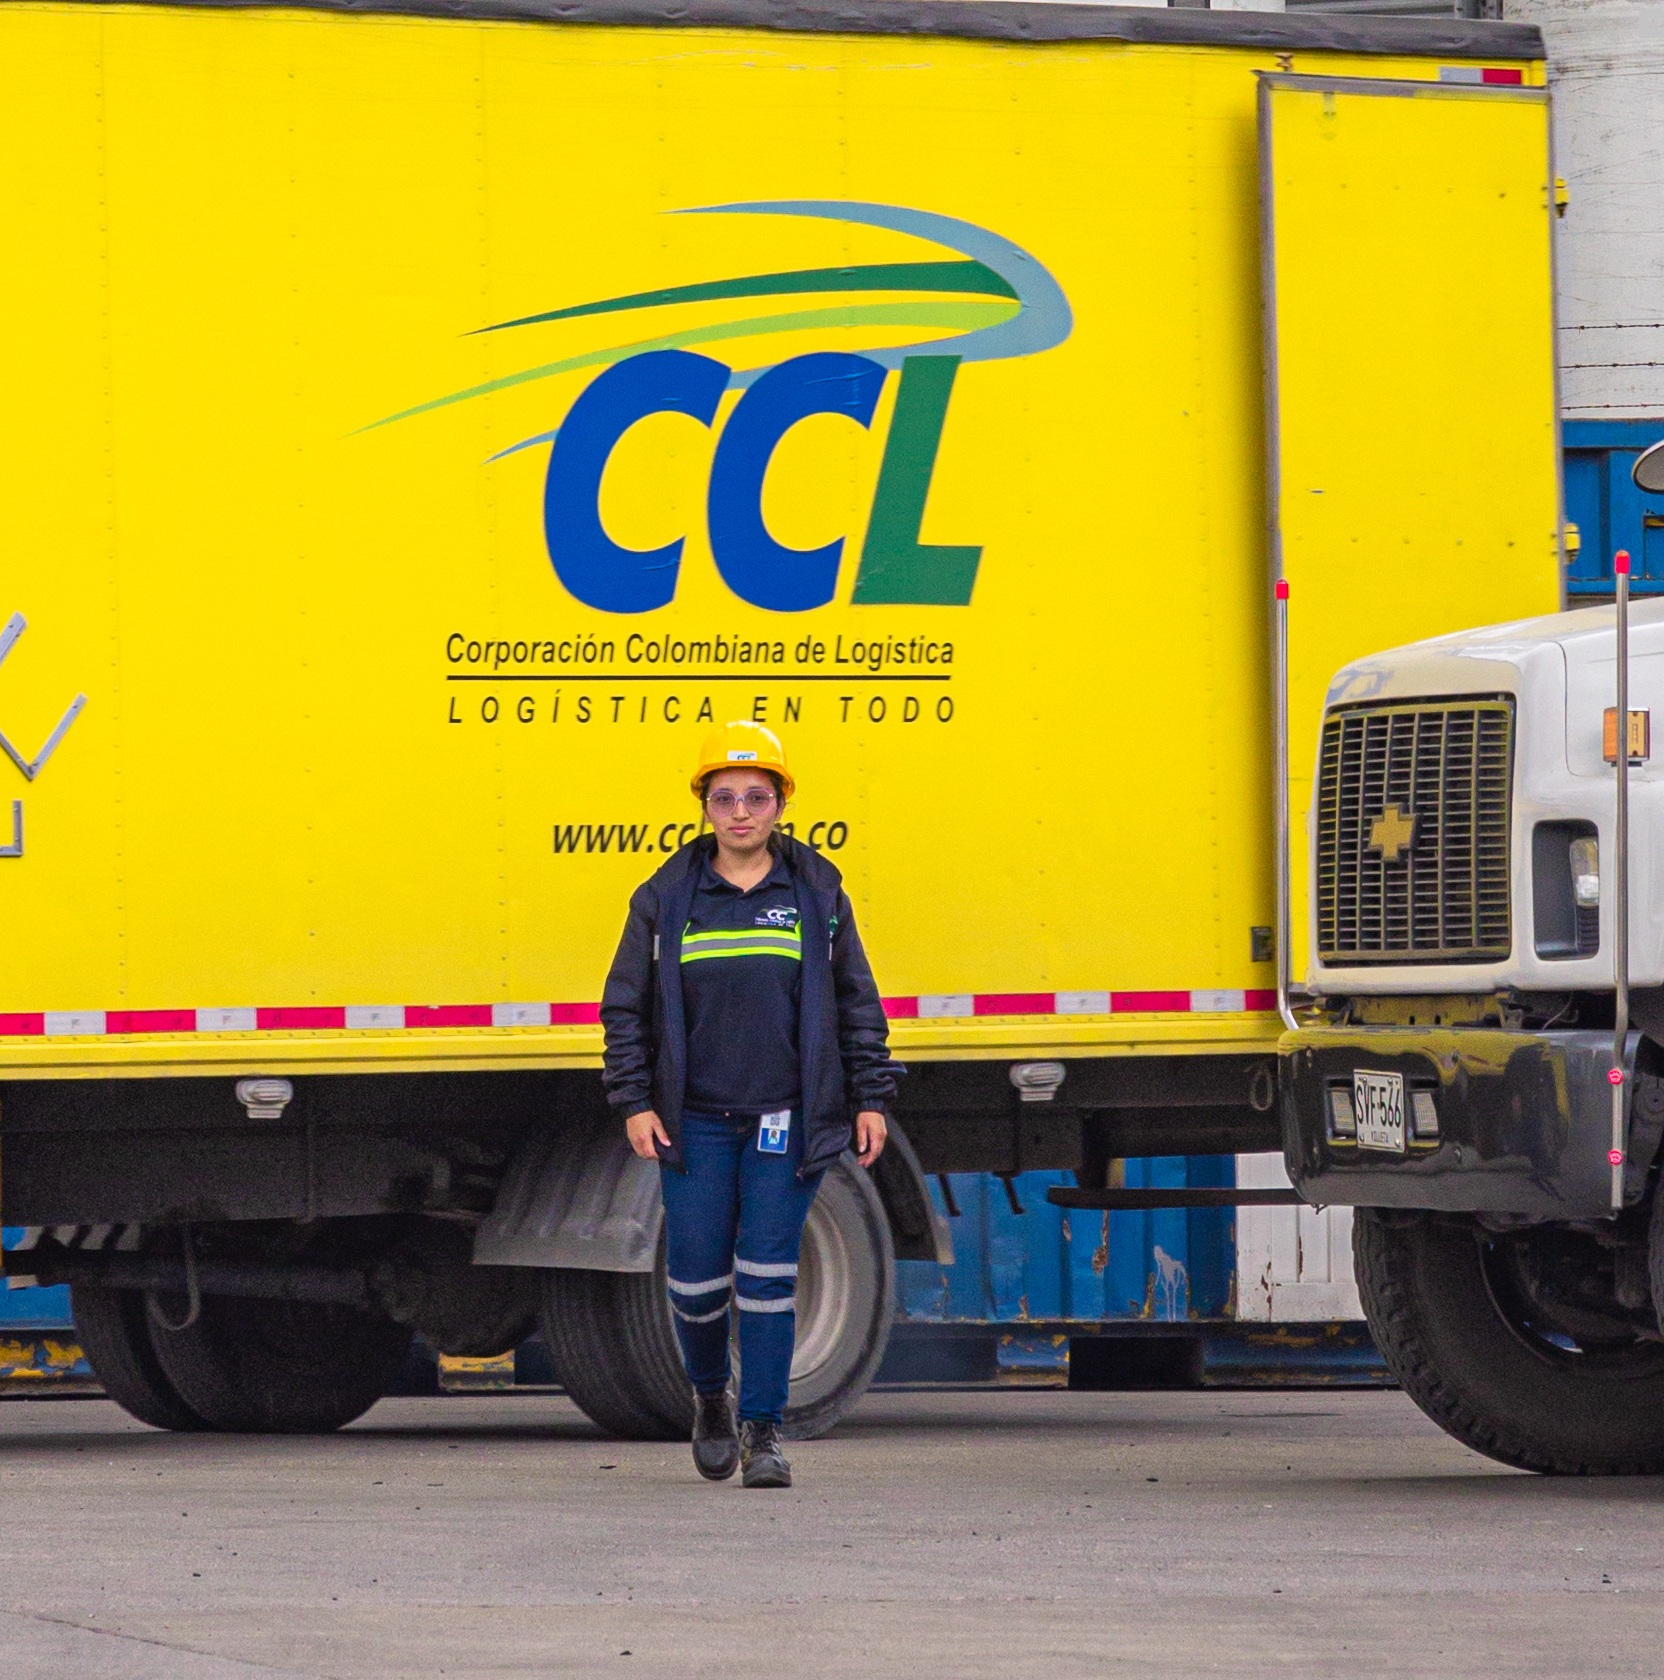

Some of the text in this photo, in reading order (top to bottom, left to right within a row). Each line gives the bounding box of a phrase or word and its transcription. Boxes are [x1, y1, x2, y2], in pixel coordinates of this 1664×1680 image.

[543, 349, 984, 614] CCL
[446, 633, 615, 670] Corporación
[626, 633, 785, 664] Colombiana
[795, 635, 826, 664] de
[448, 688, 955, 724] LOGÍSTICA EN TODO
